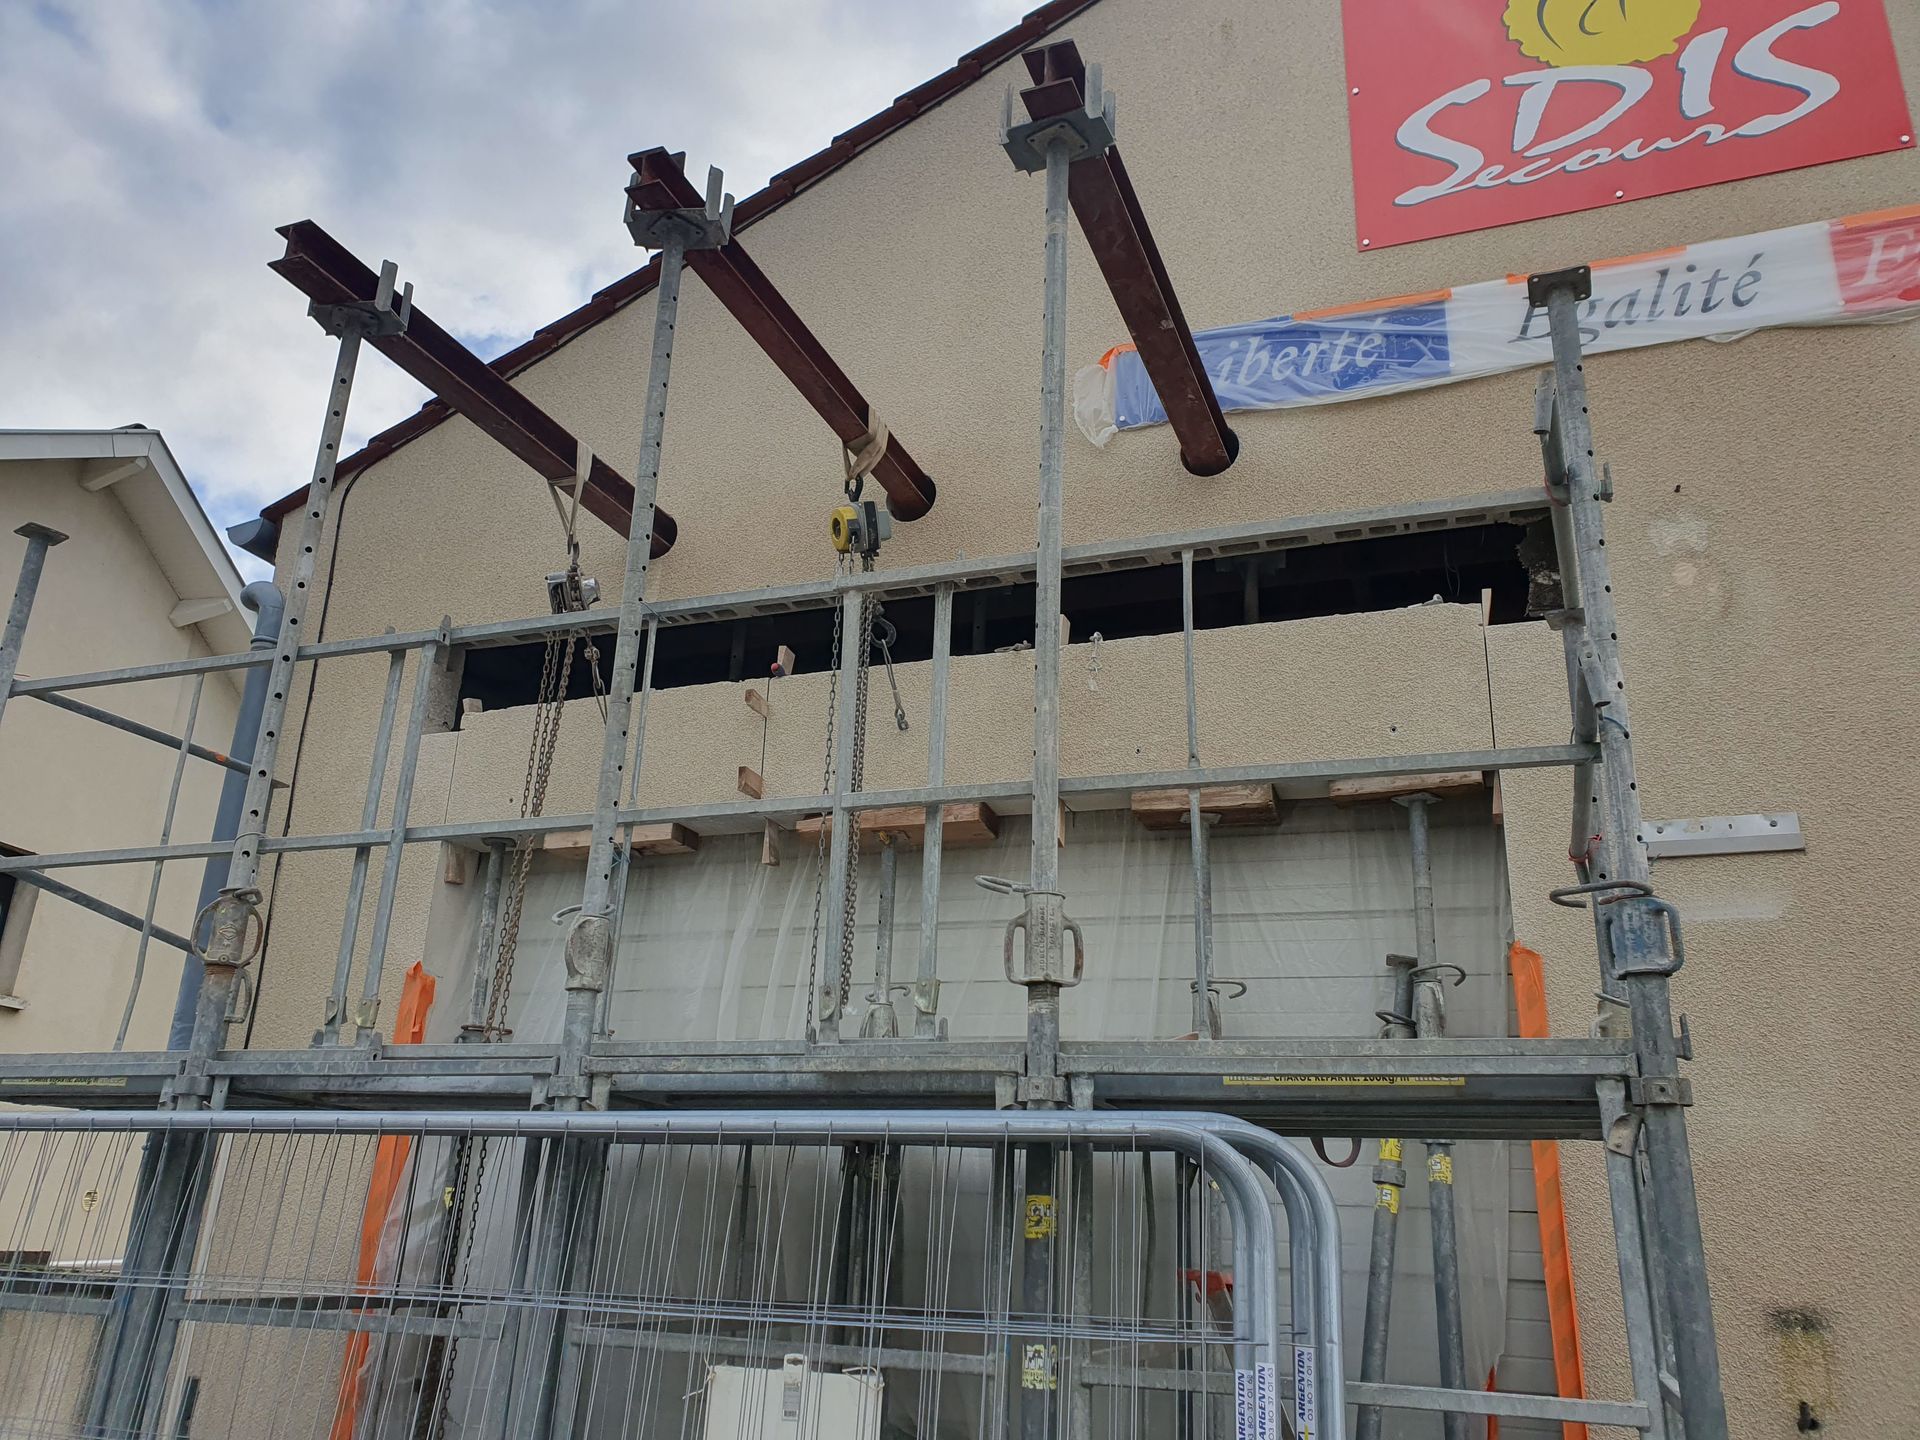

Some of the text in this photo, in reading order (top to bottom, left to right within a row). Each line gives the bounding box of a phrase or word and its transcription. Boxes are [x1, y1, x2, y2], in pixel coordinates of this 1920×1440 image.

[1396, 1, 1840, 200] SDIS
[1214, 317, 1386, 388] iberté
[1257, 1365, 1267, 1440] ARGENTON
[1297, 1349, 1306, 1422] ARGENTON
[1307, 1379, 1313, 1388] 37
[1307, 1408, 1314, 1421] 03
